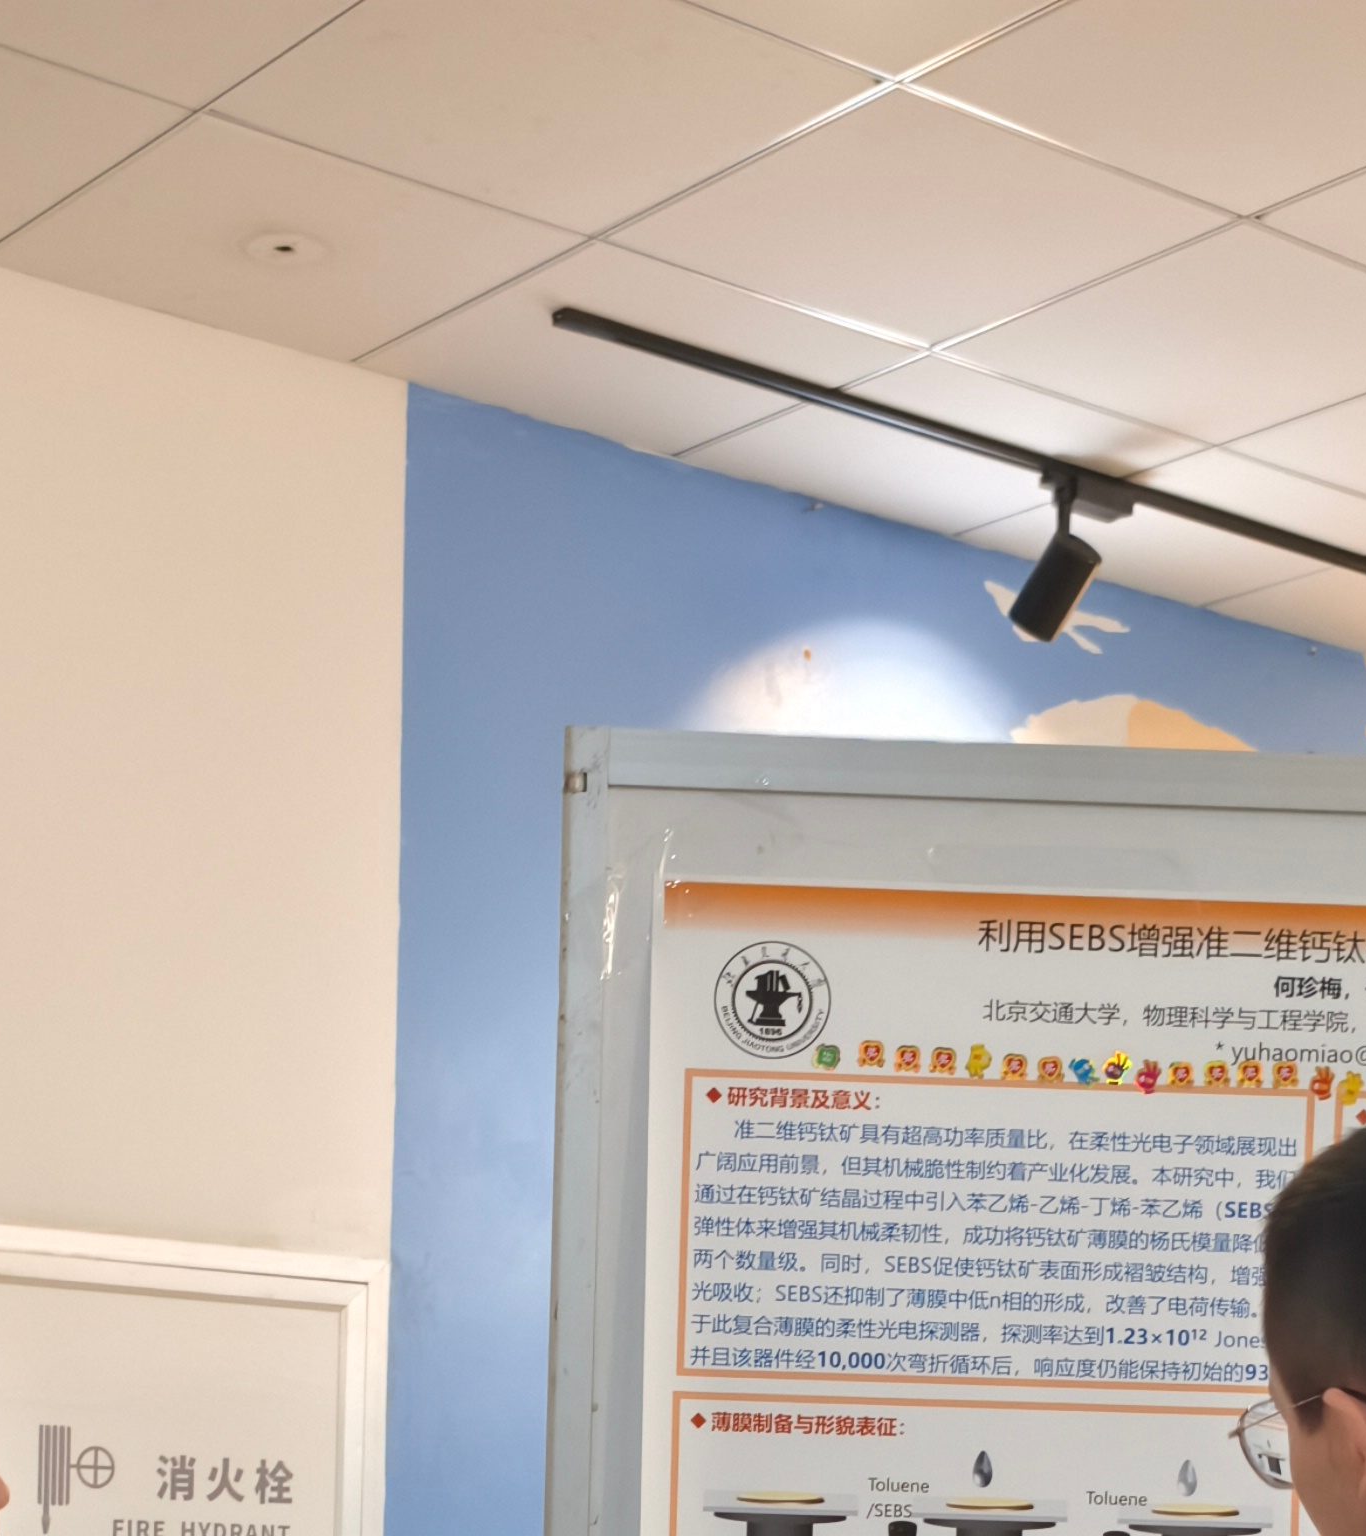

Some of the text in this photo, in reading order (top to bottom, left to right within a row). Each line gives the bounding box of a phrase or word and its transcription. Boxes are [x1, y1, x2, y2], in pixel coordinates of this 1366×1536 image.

[157, 1454, 294, 1505] 消火栓
[868, 1477, 930, 1493] Toluene
[1086, 1490, 1148, 1507] Toluene
[866, 1502, 913, 1520] /SEBS
